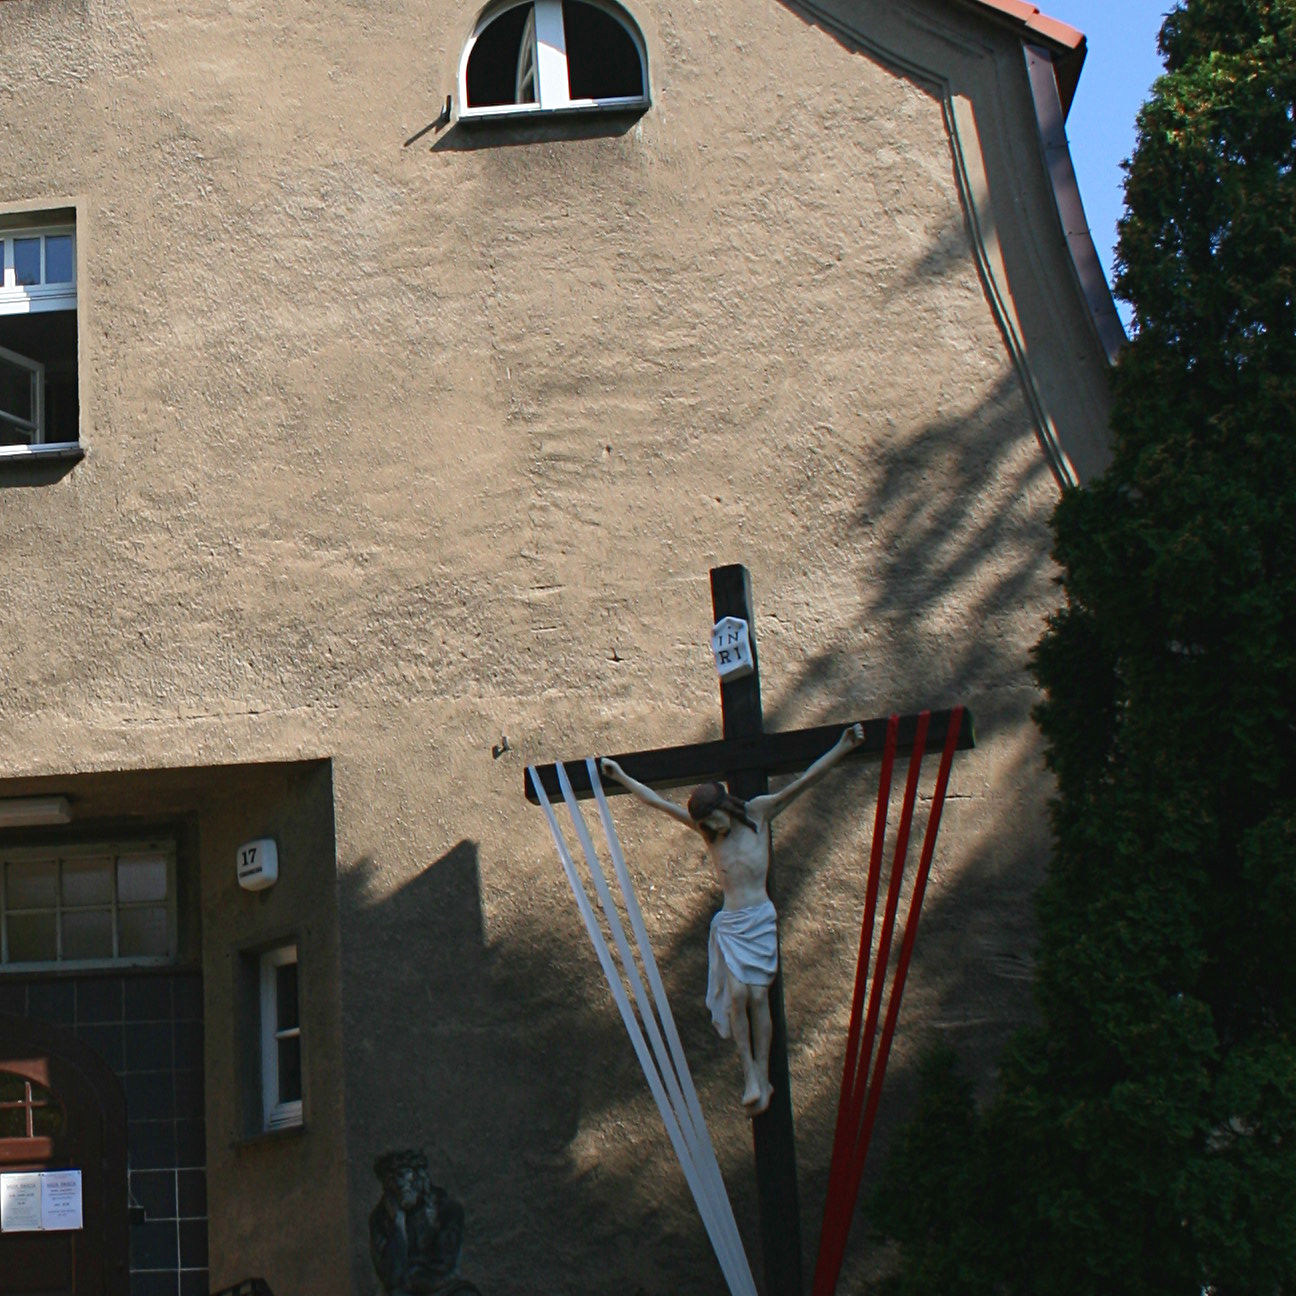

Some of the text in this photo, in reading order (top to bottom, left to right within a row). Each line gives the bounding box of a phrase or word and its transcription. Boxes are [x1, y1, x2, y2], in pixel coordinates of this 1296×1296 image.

[718, 631, 739, 646] IN
[718, 647, 741, 665] RI
[241, 847, 257, 866] 17
